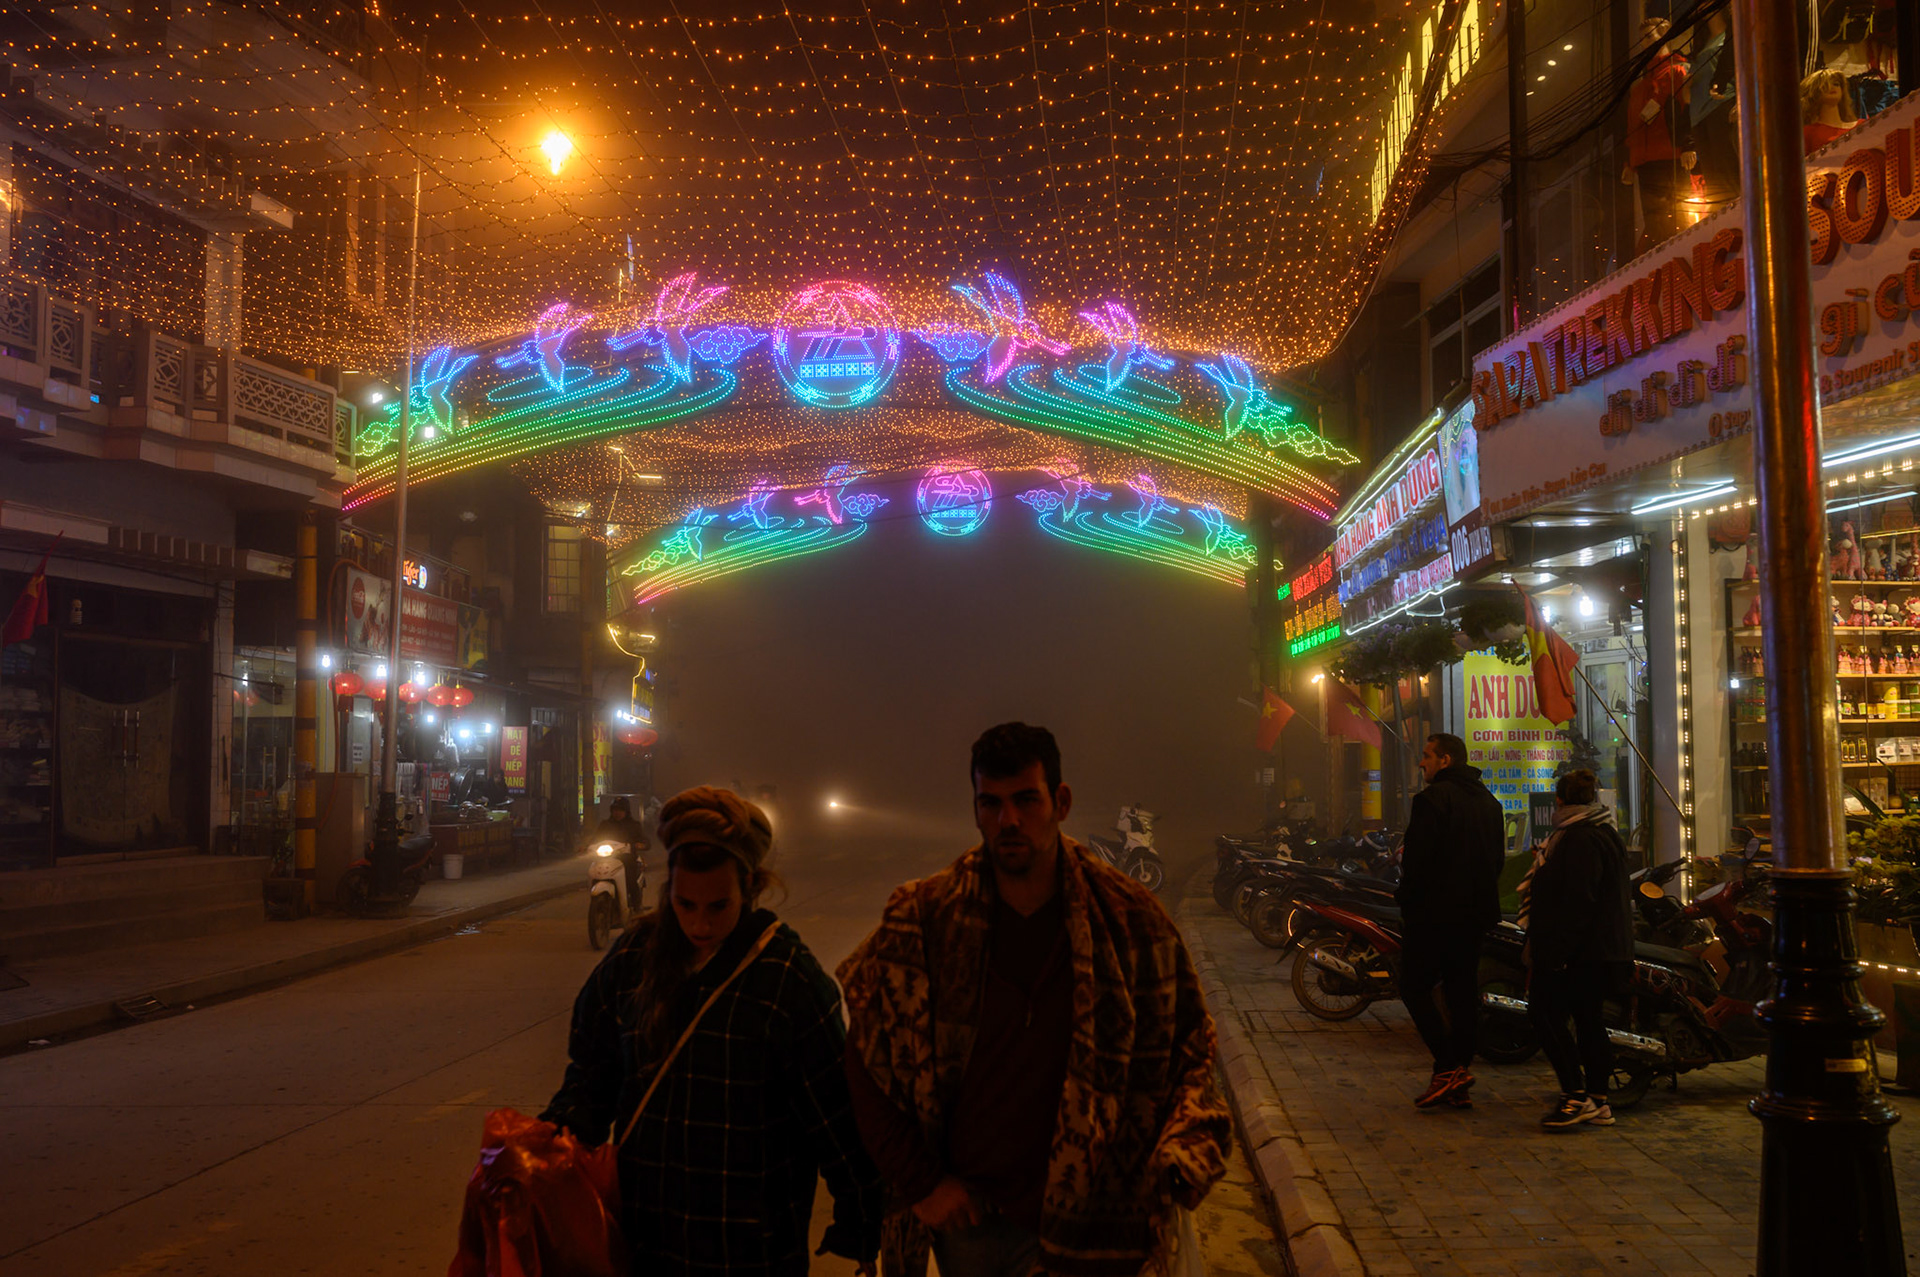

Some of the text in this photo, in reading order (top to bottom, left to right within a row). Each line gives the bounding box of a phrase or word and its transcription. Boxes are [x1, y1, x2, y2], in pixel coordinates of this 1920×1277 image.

[1472, 227, 1745, 432] SAPA TREKKING
[1833, 348, 1906, 390] Souvenir
[1335, 448, 1441, 571] NHÀ HÀNG ANH DŨNG
[1451, 524, 1470, 573] 006
[1468, 674, 1510, 719] ANH
[1473, 730, 1504, 742] CƠM
[1508, 728, 1540, 742] BÌNH
[506, 758, 522, 771] NẾP
[1498, 766, 1508, 779] CÁ
[1527, 766, 1536, 779] CÁ
[432, 774, 449, 791] NẾP
[1504, 799, 1513, 810] SA
[1514, 799, 1523, 810] PA
